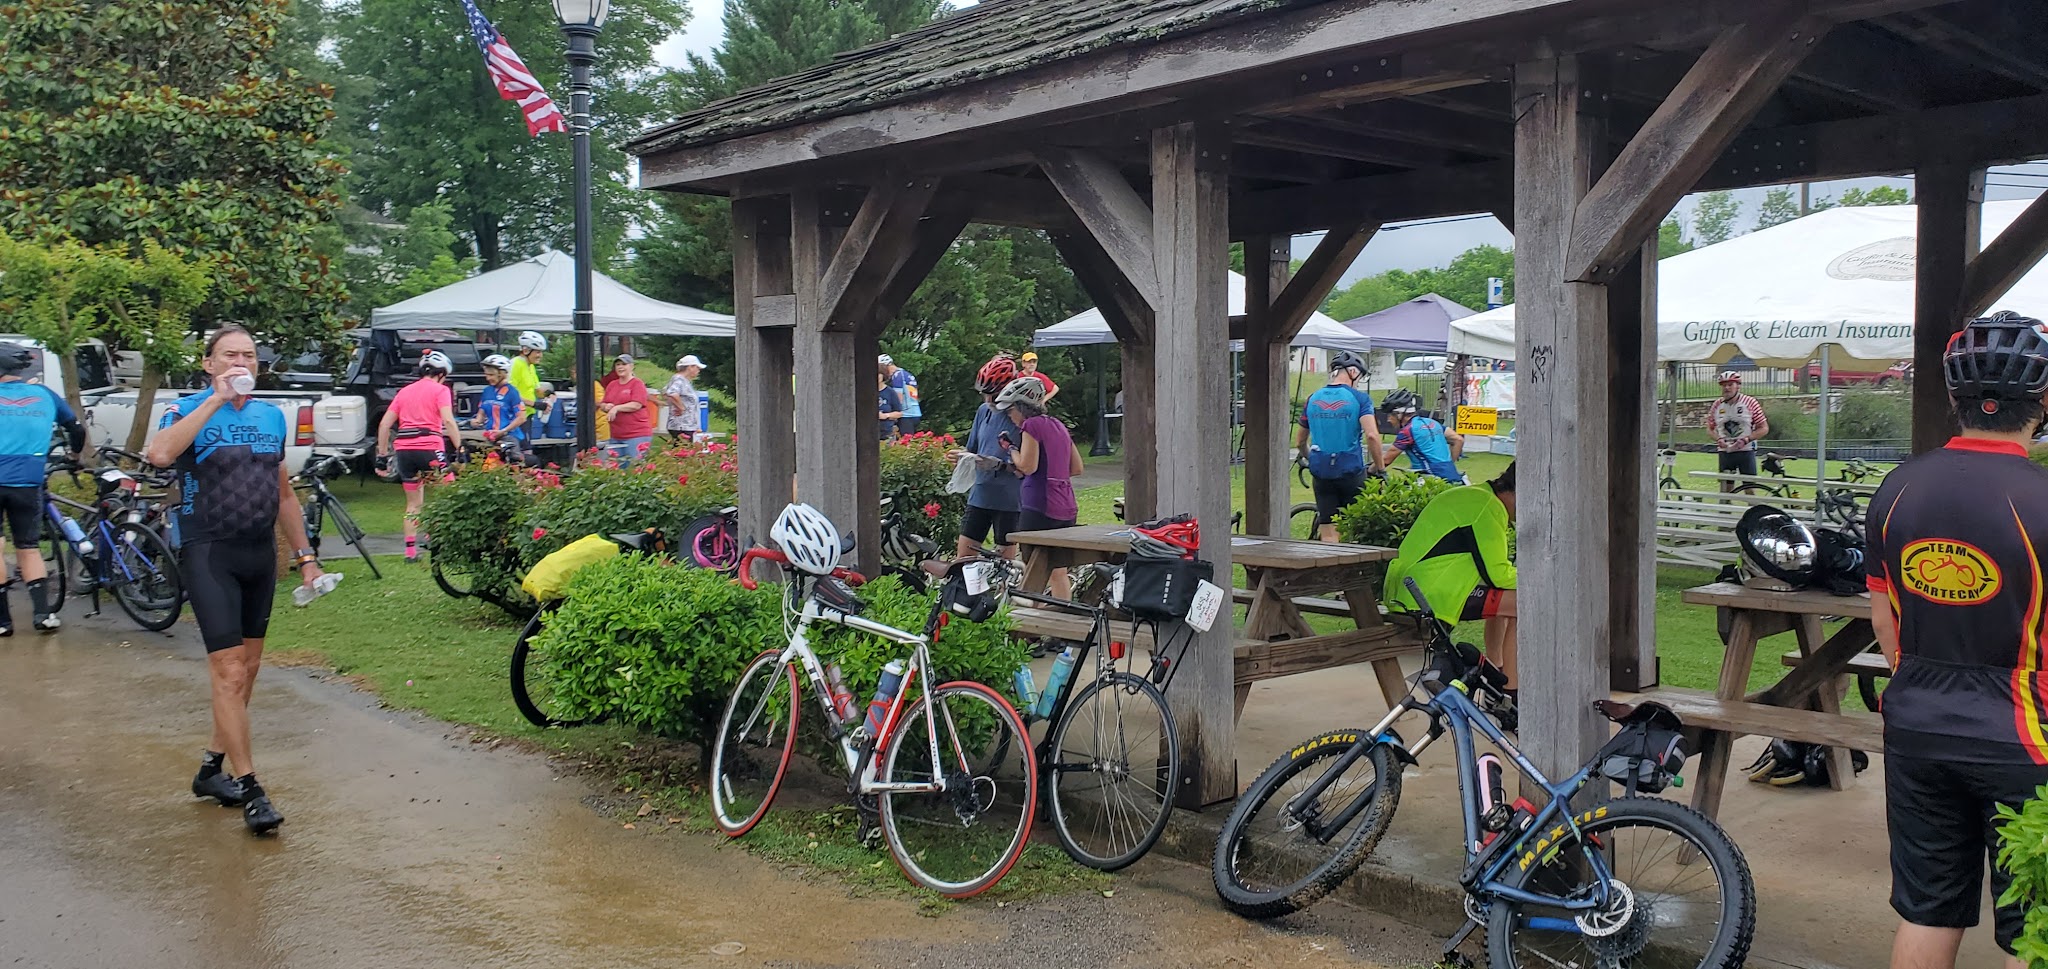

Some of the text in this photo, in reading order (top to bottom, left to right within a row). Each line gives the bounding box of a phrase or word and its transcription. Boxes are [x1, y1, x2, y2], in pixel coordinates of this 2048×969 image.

[1684, 321, 1735, 344] Guffin
[1744, 321, 1760, 339] &
[1767, 320, 1828, 339] Eleam
[228, 424, 259, 432] Cross
[1458, 422, 1495, 431] STATION
[232, 432, 280, 444] FLORIDA
[1928, 543, 1967, 557] TEAM
[1914, 579, 1979, 600] CARTECAY
[1291, 733, 1357, 760] MAXXIS
[1518, 806, 1608, 872] MAXXIS
